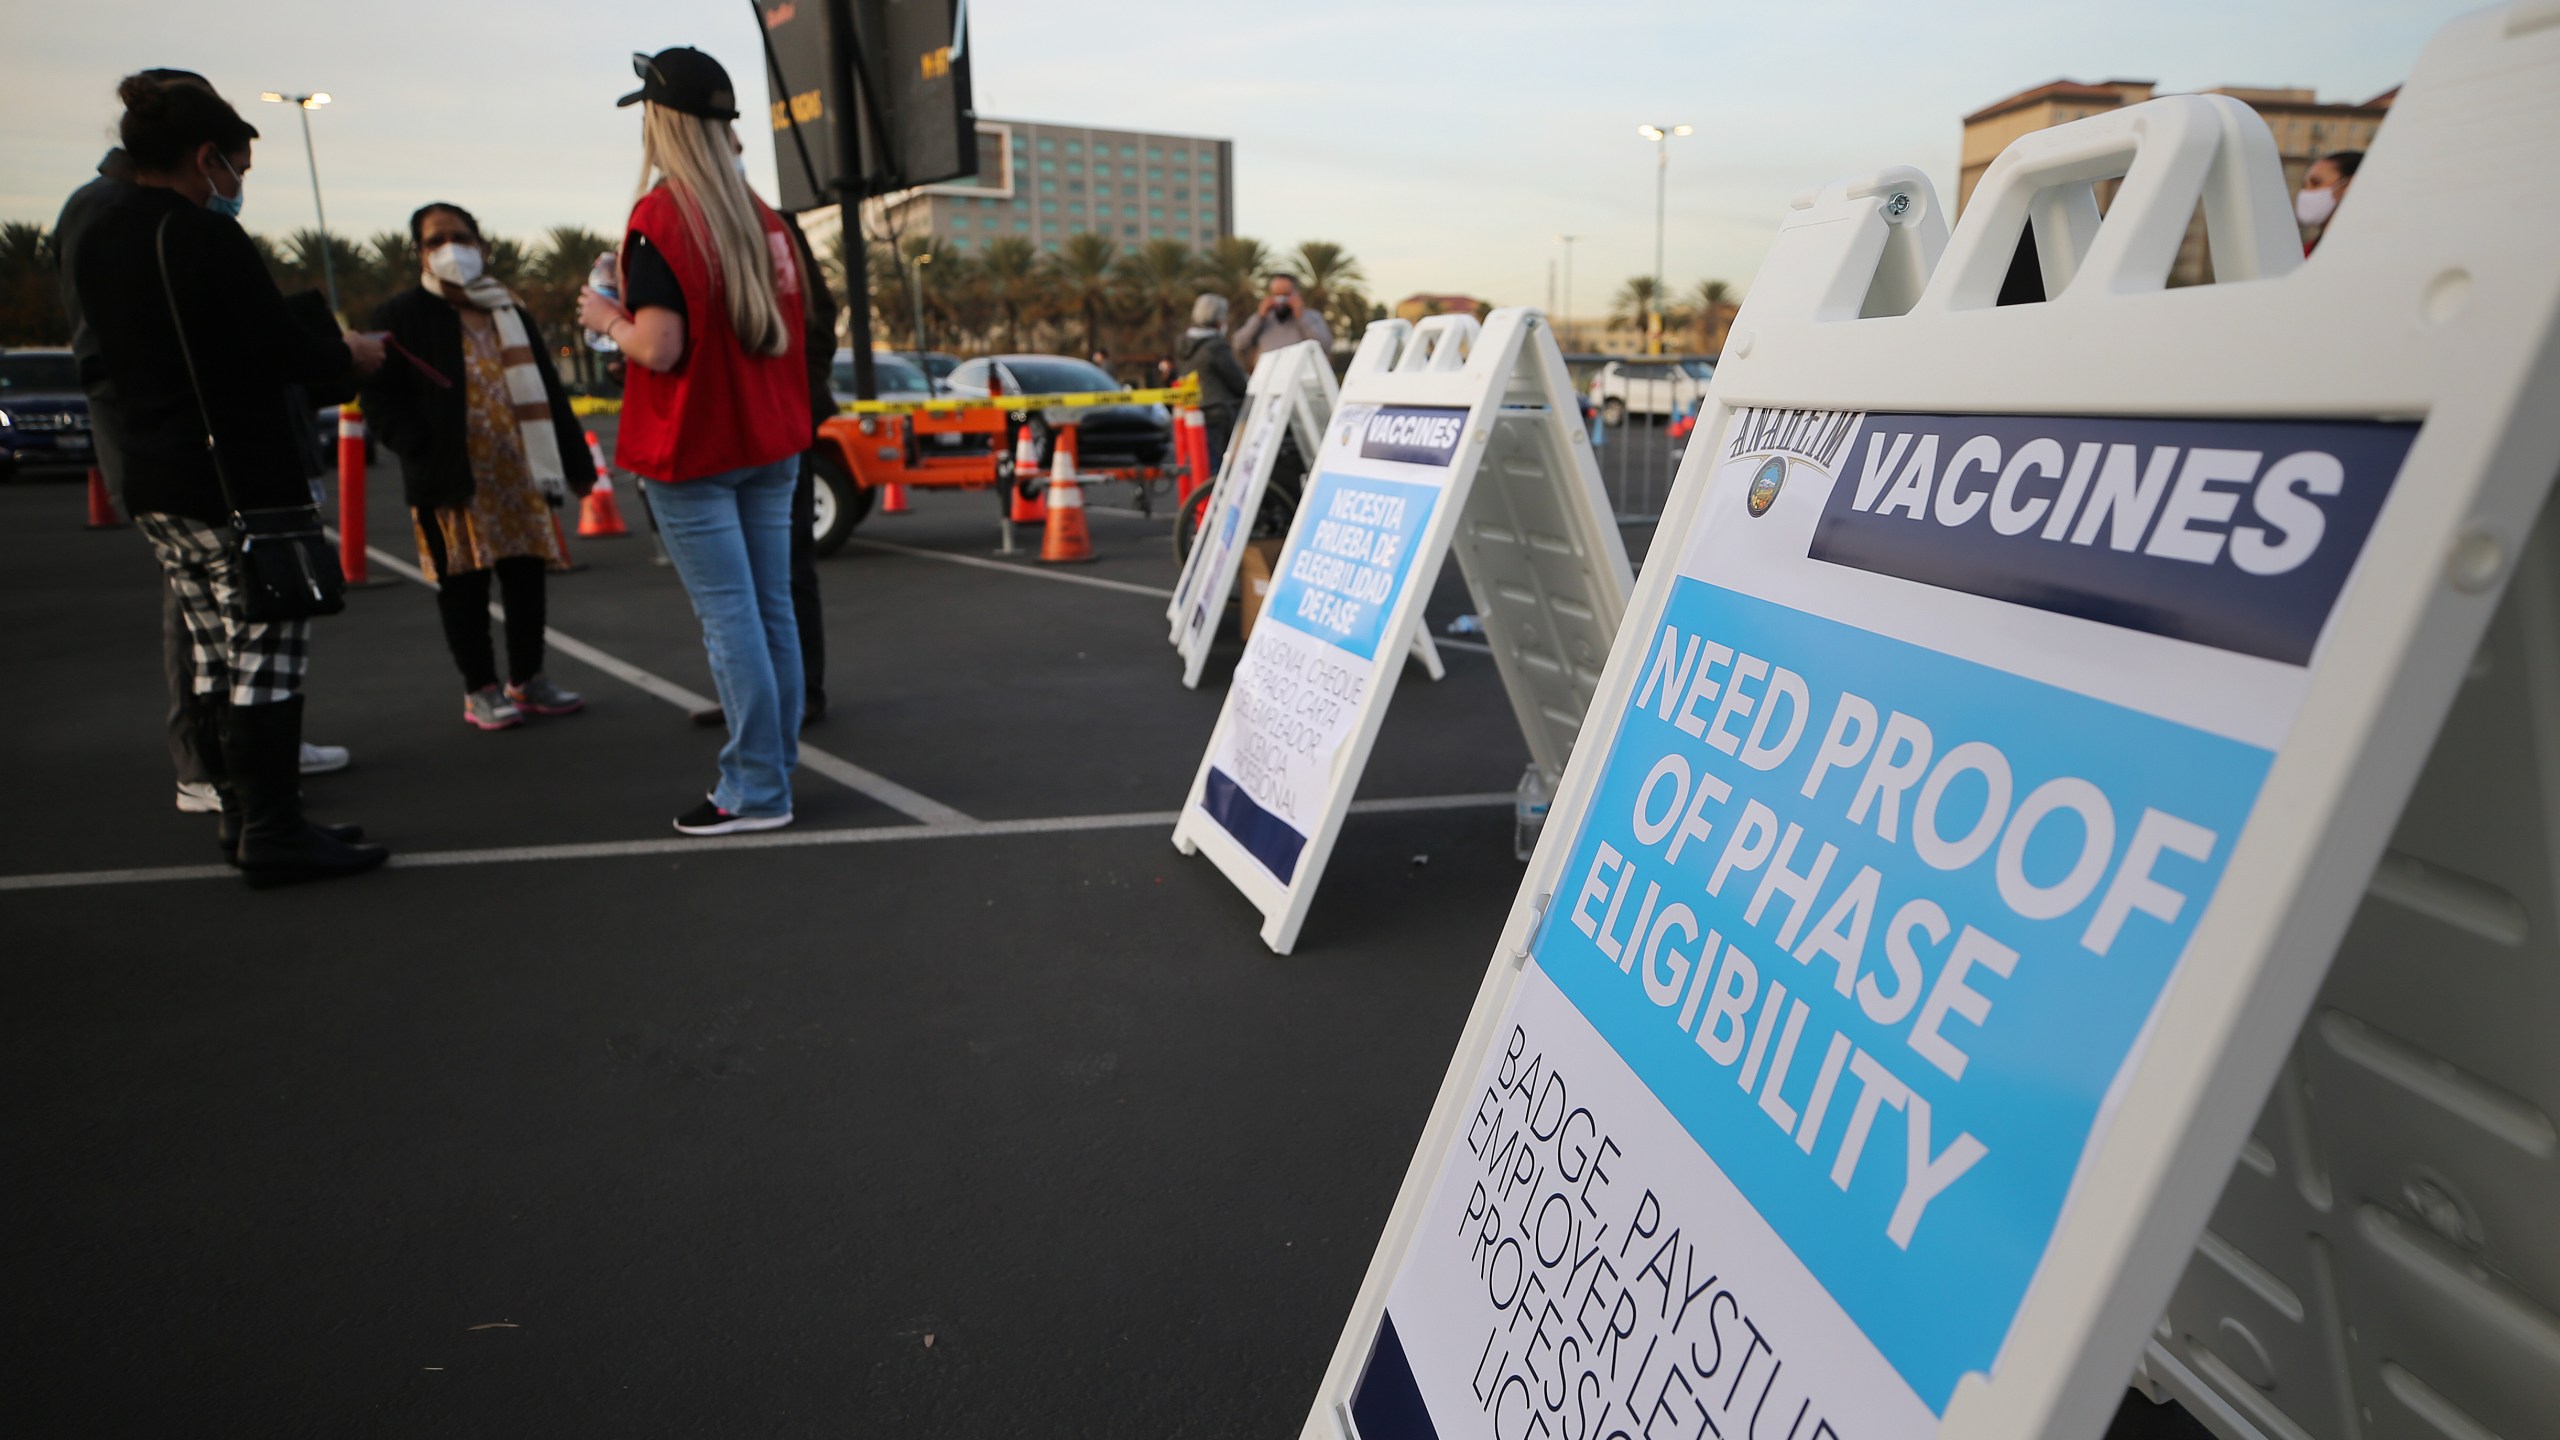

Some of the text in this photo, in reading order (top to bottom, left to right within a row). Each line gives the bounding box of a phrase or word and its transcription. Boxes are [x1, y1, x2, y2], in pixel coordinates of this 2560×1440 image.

[1368, 414, 1461, 450] VACCINES
[1729, 407, 1861, 468] ANAHEIM
[1328, 487, 1405, 530] NECESITA
[1851, 432, 2345, 576] VACCINES
[1311, 518, 1401, 568] PRUEBA DE
[1291, 548, 1394, 606] ELEGIBILIDAD
[1297, 586, 1361, 635] DE FASE
[1295, 689, 1341, 732] CARTA
[1306, 658, 1364, 706] CHEQUE
[1635, 624, 2219, 957] NEED PROOF
[1632, 752, 2021, 1083] OF PHASE
[1570, 839, 1990, 1252] ELIGIBILITY
[1497, 1024, 1840, 1440] BADGE, PAYSTU
[1466, 1086, 1725, 1440] EMPLOYER LET
[1459, 1179, 1634, 1440] PROFESSI
